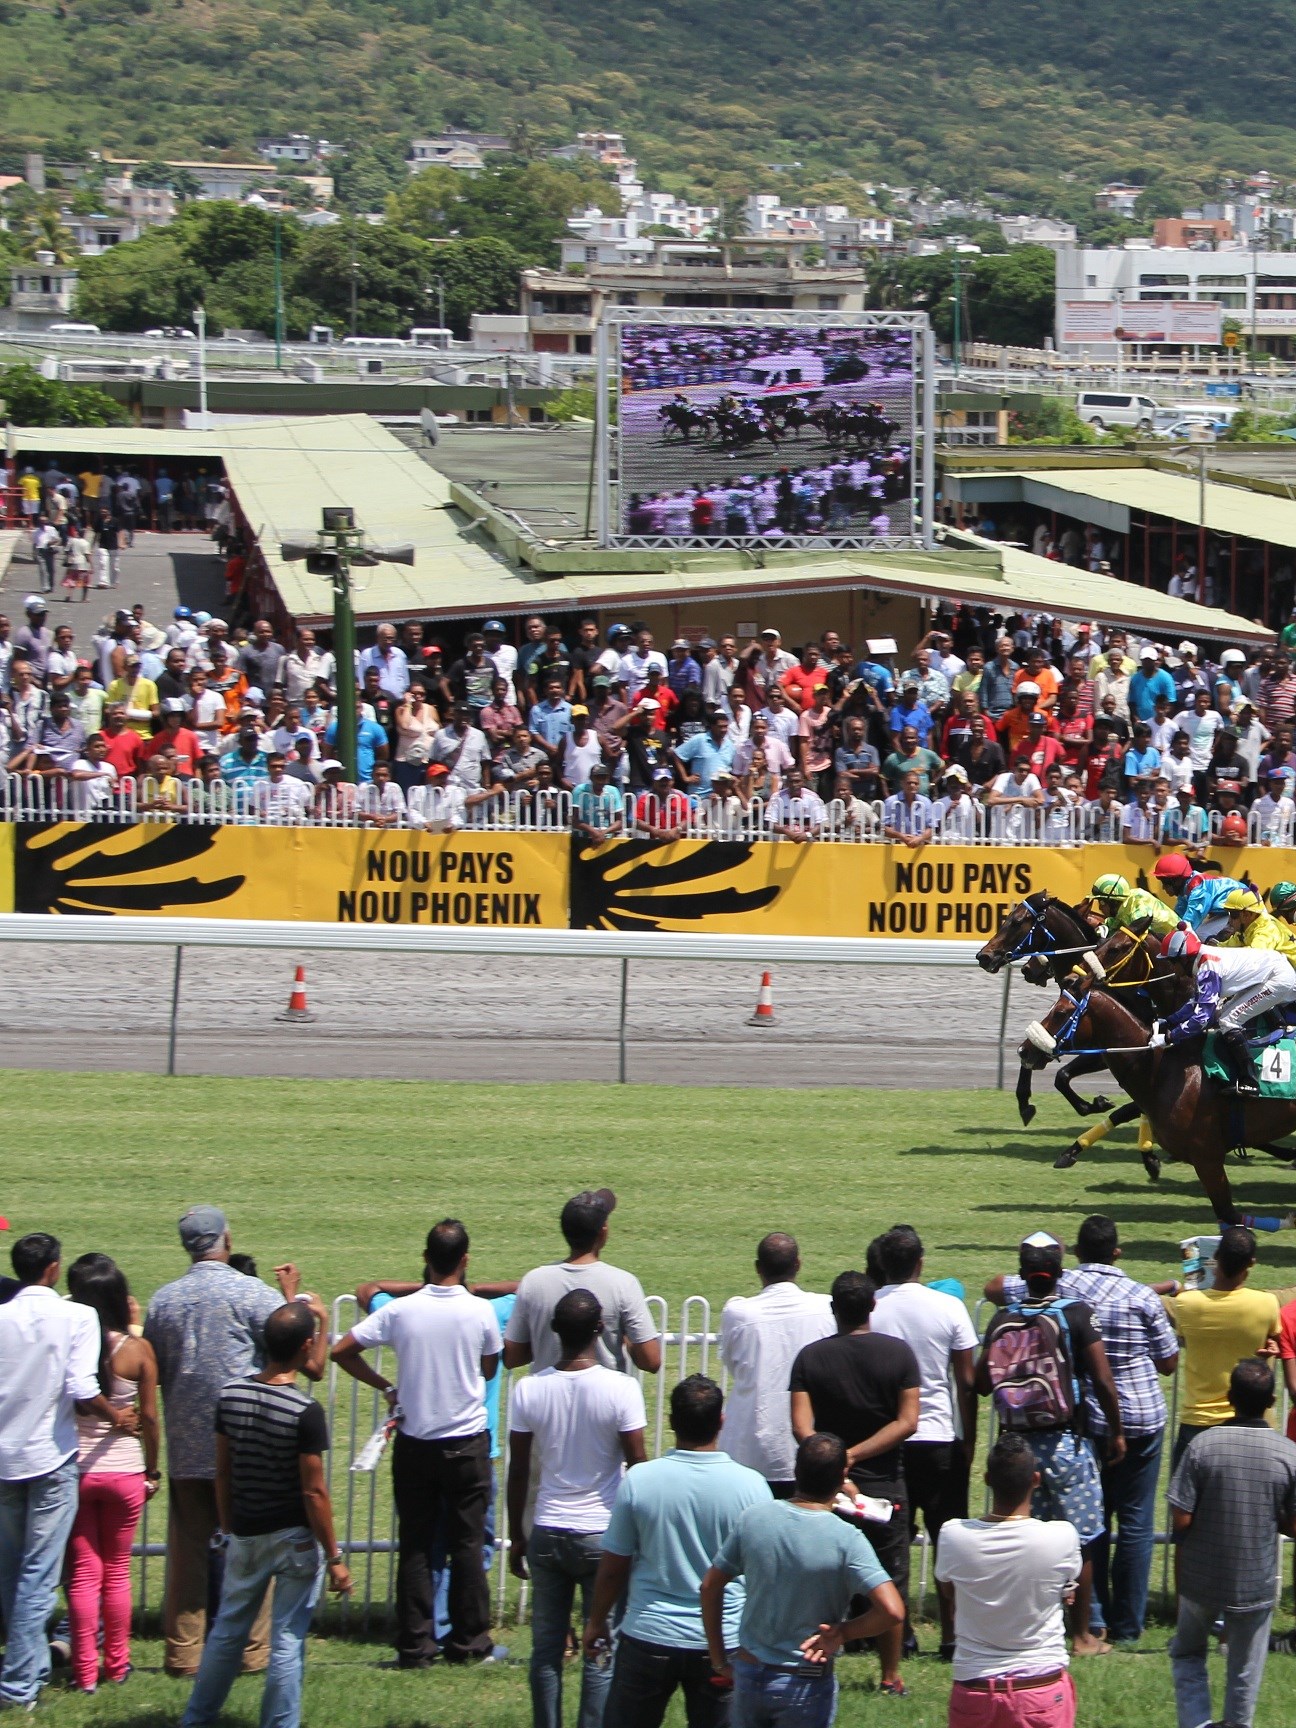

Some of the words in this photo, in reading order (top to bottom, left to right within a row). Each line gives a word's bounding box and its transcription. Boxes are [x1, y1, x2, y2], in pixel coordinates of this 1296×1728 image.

[367, 849, 431, 883] NOU
[440, 851, 514, 885] PAYS
[896, 862, 954, 894] NOU
[963, 863, 1032, 894] PAYS
[338, 890, 402, 923] NOU
[411, 891, 542, 925] PHOENIX
[868, 901, 927, 933] NOU
[1269, 1051, 1283, 1078] 4
